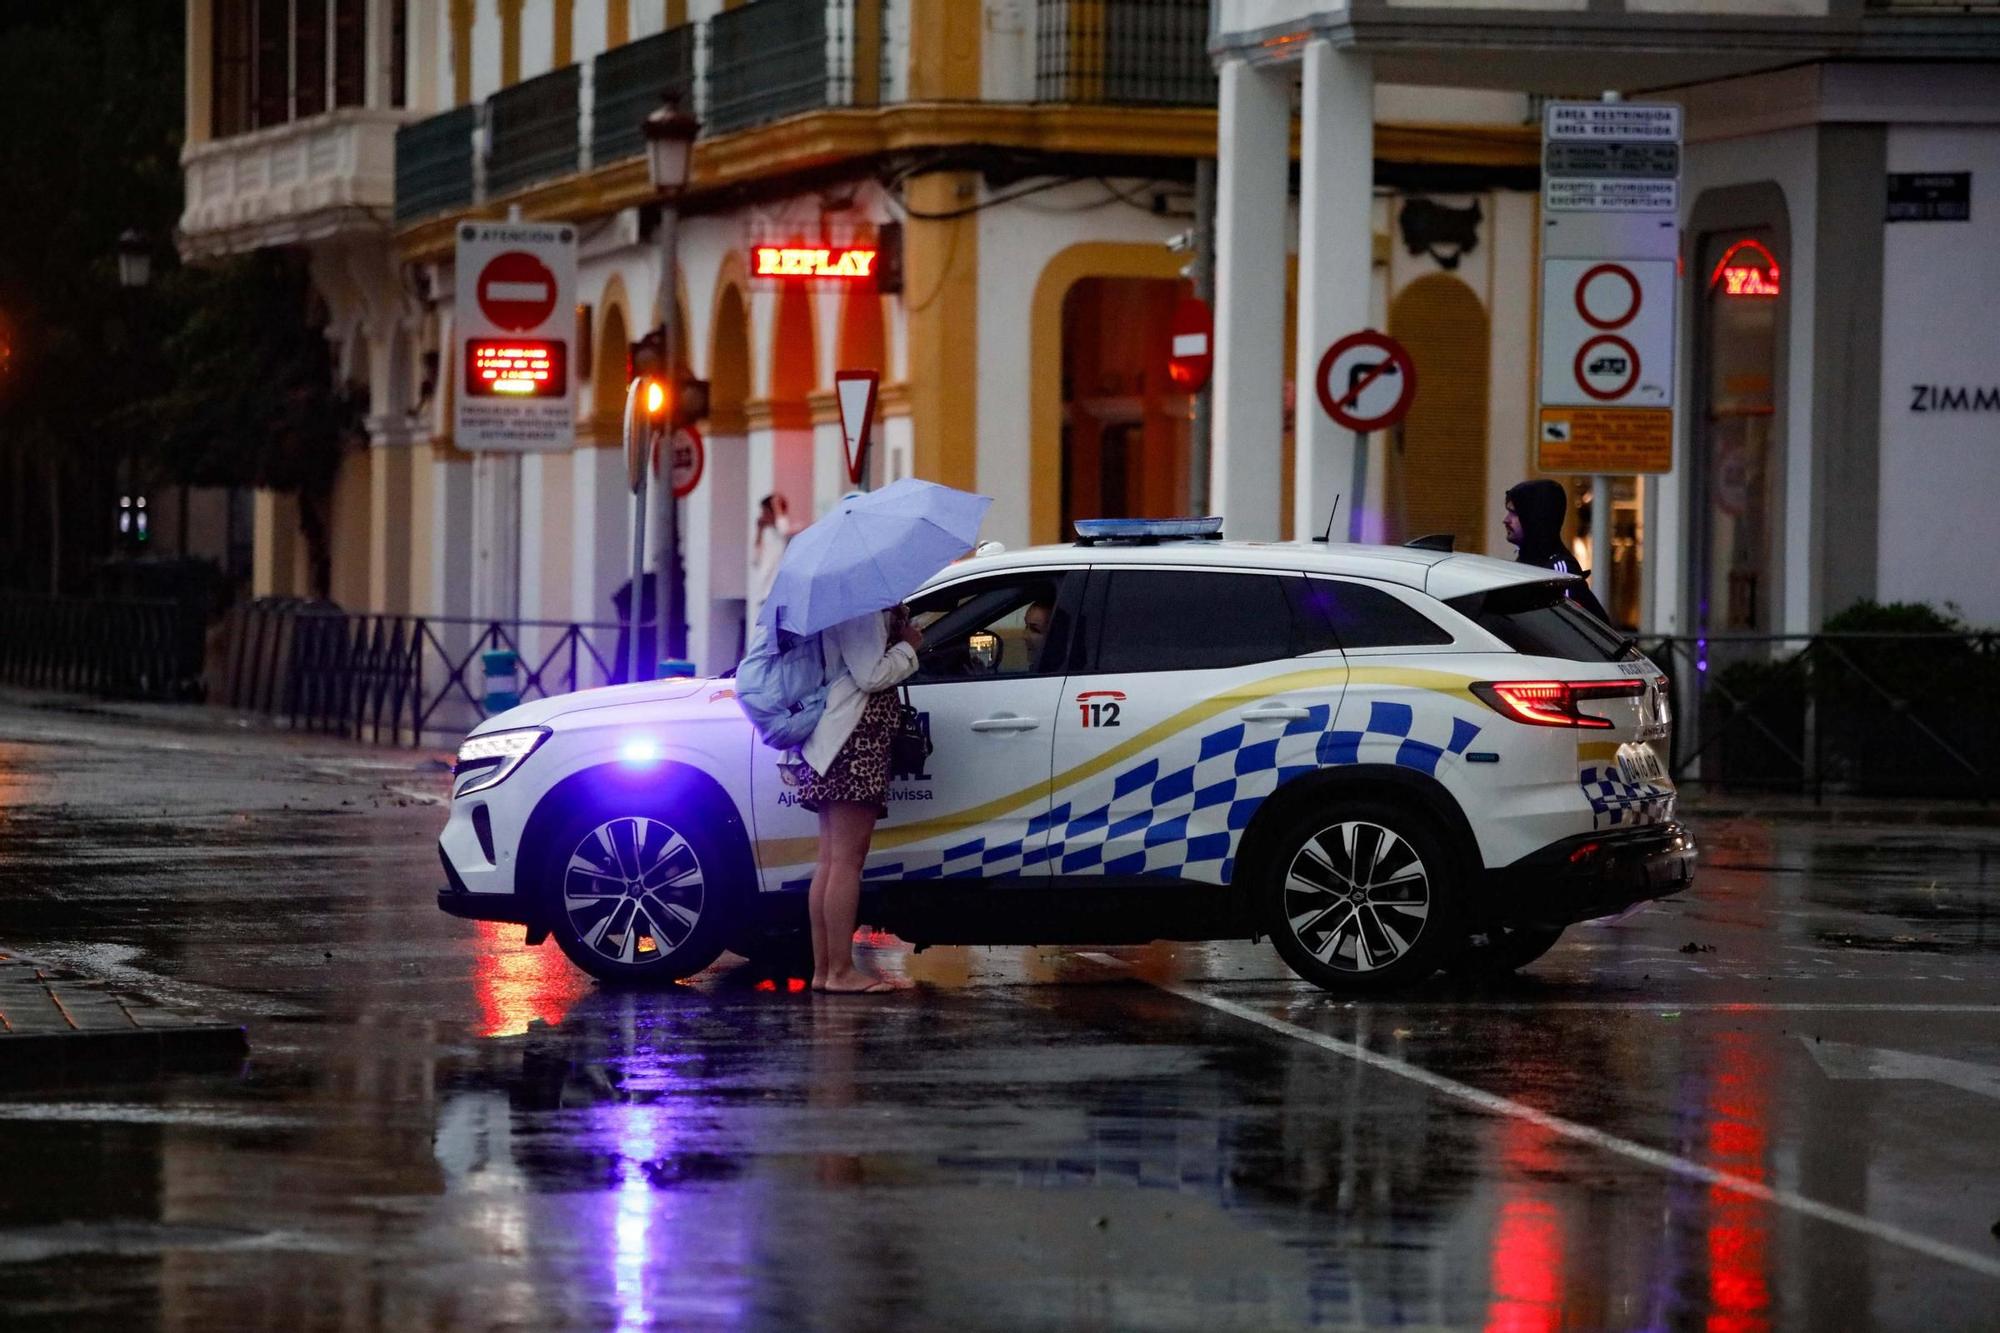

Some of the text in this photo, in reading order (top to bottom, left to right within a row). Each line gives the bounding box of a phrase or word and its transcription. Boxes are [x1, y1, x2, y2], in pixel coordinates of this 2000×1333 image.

[757, 248, 875, 276] REPLAY
[1910, 384, 2000, 411] ZIMM
[1079, 703, 1120, 728] 112
